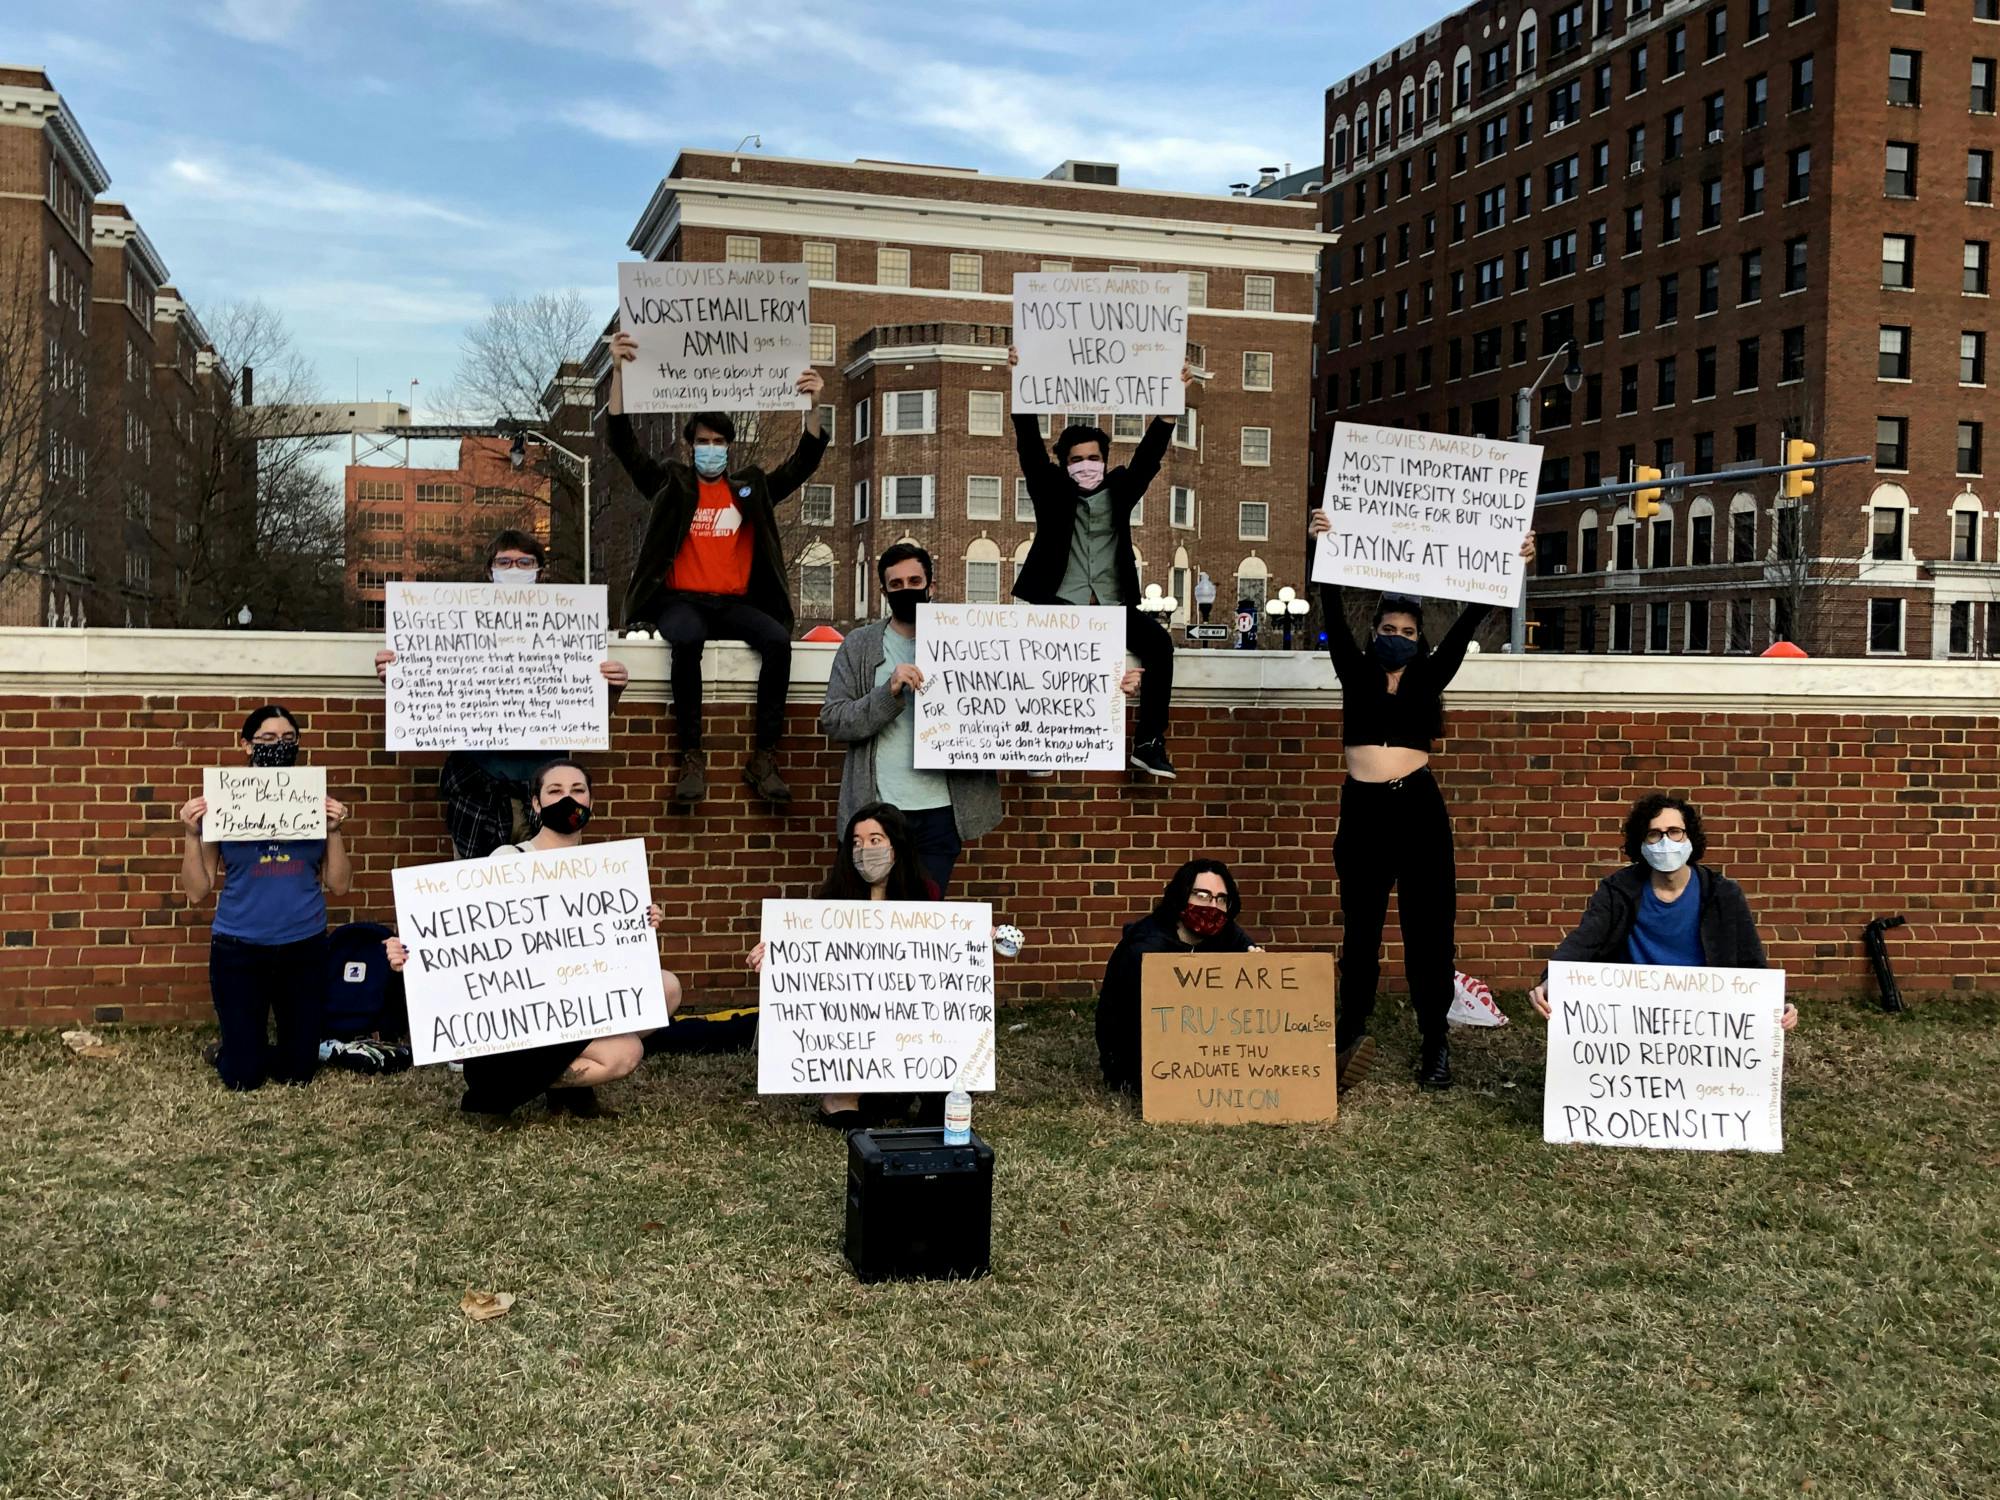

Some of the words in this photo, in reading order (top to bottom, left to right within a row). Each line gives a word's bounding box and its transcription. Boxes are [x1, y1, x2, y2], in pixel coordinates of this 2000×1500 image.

[625, 297, 694, 324] WORST
[699, 298, 758, 322] EMAIL
[762, 299, 808, 325] FROM
[1022, 302, 1082, 330] MOST
[1090, 302, 1183, 333] UNSUNG
[684, 331, 748, 356] ADMIN
[1069, 337, 1125, 365] HERO
[658, 363, 685, 379] the
[694, 366, 720, 379] one
[724, 364, 764, 379] about
[769, 367, 790, 378] our
[653, 385, 707, 404] amazing
[712, 384, 754, 401] budget
[1020, 375, 1109, 405] CLEANING
[1116, 376, 1172, 406] STAFF
[1338, 473, 1361, 483] that
[1342, 452, 1395, 473] MOST
[1401, 458, 1493, 482] IMPORTANT
[1500, 468, 1528, 488] PPE
[1342, 483, 1357, 492] the
[1364, 478, 1455, 503] UNIVERSITY
[1463, 490, 1525, 509] SHOULD
[1333, 495, 1352, 511] BE
[1359, 497, 1420, 519] PAYING
[1425, 507, 1451, 523] FOR
[1456, 509, 1481, 525] BUT
[1490, 514, 1526, 532] ISN'T
[1326, 532, 1414, 562] STAYING
[1423, 542, 1449, 567] AT
[1458, 545, 1513, 575] HOME
[1446, 576, 1508, 599] trujhu.org
[393, 610, 468, 630] BIGGEST
[475, 610, 522, 630] REACH
[543, 612, 599, 630] ADMIN
[394, 633, 497, 651] EXPLANATION
[532, 633, 544, 650] A
[927, 640, 1011, 662] VAGUEST
[1019, 639, 1101, 661] PROMISE
[401, 654, 432, 667] telling
[436, 656, 484, 667] everyone
[488, 652, 514, 662] that
[518, 652, 552, 665] having
[564, 652, 592, 663] police
[406, 678, 442, 692] calling
[448, 678, 472, 692] grad
[476, 677, 520, 685] workers
[524, 675, 567, 684] essential
[573, 675, 591, 684] but
[943, 670, 1035, 694] FINANCIAL
[1042, 671, 1109, 693] SUPPORT
[923, 702, 948, 718] FOR
[958, 698, 1006, 716] GRAD
[1016, 698, 1095, 717] WORKERS
[409, 725, 467, 736] explaining
[472, 723, 492, 736] why
[498, 724, 526, 736] they
[530, 724, 557, 732] can't
[580, 722, 599, 731] the
[960, 720, 1000, 740] making
[1002, 723, 1012, 732] it
[1037, 723, 1109, 736] department-
[416, 737, 456, 747] budget
[464, 737, 509, 748] surplus
[932, 737, 975, 751] specific
[979, 739, 991, 748] so
[996, 739, 1012, 748] we
[1015, 737, 1041, 748] don't
[1045, 739, 1072, 748] know
[1076, 739, 1113, 750] what's
[948, 751, 979, 764] going
[1000, 752, 1023, 762] with
[1028, 752, 1052, 763] each
[1055, 752, 1089, 763] other!
[220, 771, 269, 795] Ronny
[277, 771, 290, 787] D
[232, 791, 247, 800] for
[256, 788, 284, 802] Best
[410, 895, 550, 938] WEIRDEST
[561, 888, 639, 917] WORD
[613, 914, 646, 931] used
[784, 911, 812, 930] the
[821, 908, 884, 930] COVIES
[890, 911, 945, 929] AWARD
[951, 914, 975, 932] for
[521, 923, 605, 955] DANIELS
[616, 933, 630, 946] in
[631, 933, 647, 943] an
[965, 941, 988, 952] that
[419, 938, 512, 973] RONALD
[770, 941, 822, 965] MOST
[825, 941, 907, 962] ANNOYING
[908, 941, 963, 963] THING
[969, 956, 985, 967] the
[464, 967, 545, 1000] EMAIL
[557, 962, 590, 985] goes
[772, 973, 874, 993] UNIVERSITY
[879, 973, 915, 992] USED
[919, 975, 936, 991] TO
[940, 973, 963, 992] PAY
[966, 975, 992, 994] FOR
[1173, 966, 1224, 989] WE
[1235, 967, 1299, 989] ARE
[433, 987, 643, 1052] ACCOUNTABILITY
[770, 1003, 817, 1022] THAT
[820, 1001, 847, 1022] YOU
[851, 1003, 881, 1020] NOW
[885, 1002, 920, 1022] HAVE
[922, 1002, 939, 1020] TO
[944, 1002, 967, 1022] PAY
[969, 1004, 992, 1022] FOR
[1563, 1001, 1621, 1035] MOST
[1633, 1005, 1755, 1040] INEFFECTIVE
[1285, 1013, 1312, 1032] LOCAL
[1313, 1014, 1331, 1029] 500
[793, 1029, 876, 1052] YOURSELF
[896, 1032, 923, 1051] goes
[1199, 1045, 1230, 1056] THE
[1236, 1044, 1269, 1058] JHU
[1574, 1041, 1630, 1065] COVID
[1640, 1042, 1761, 1069] REPORTING
[792, 1058, 895, 1083] SEMINAR
[905, 1056, 957, 1079] FOOD
[1152, 1061, 1239, 1079] GRADUATE
[1248, 1064, 1321, 1078] WORKERS
[1590, 1074, 1686, 1100] SYSTEM
[1696, 1083, 1724, 1100] goes
[1198, 1089, 1280, 1108] UNION
[1563, 1106, 1751, 1141] PRODENSITY
